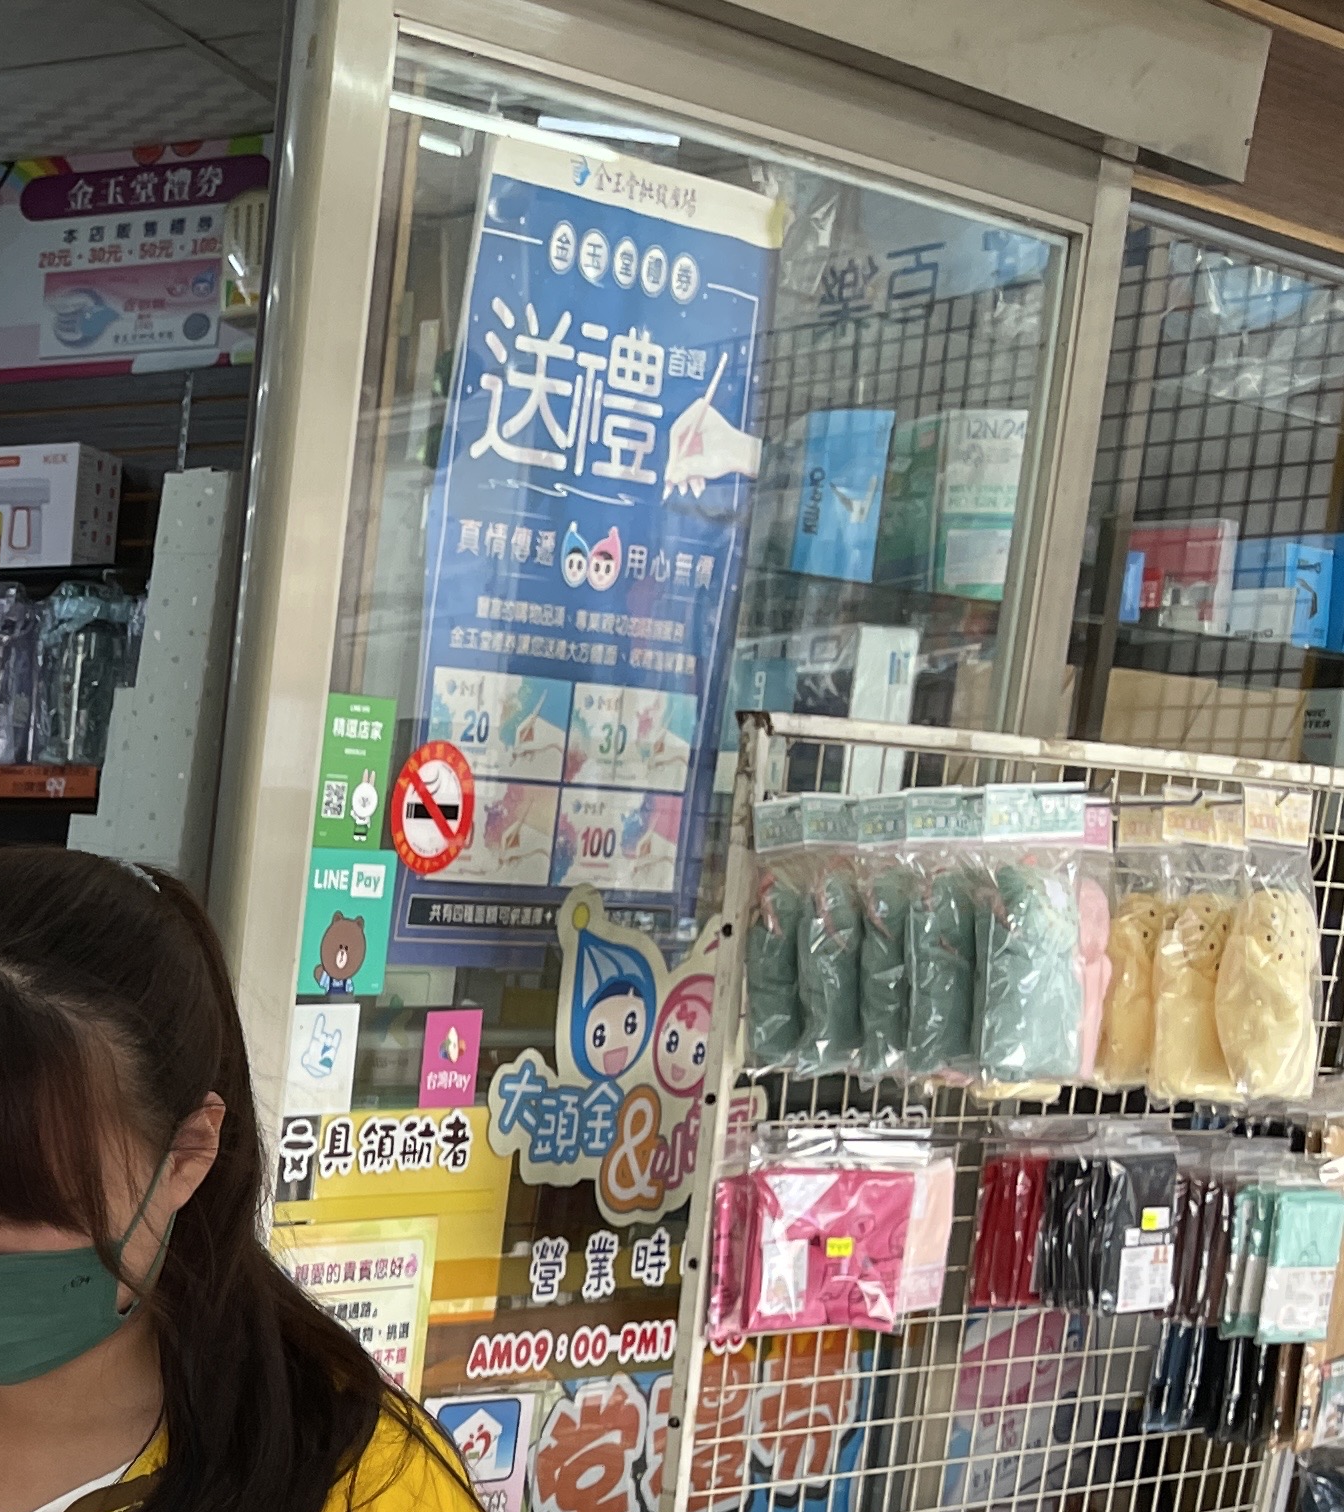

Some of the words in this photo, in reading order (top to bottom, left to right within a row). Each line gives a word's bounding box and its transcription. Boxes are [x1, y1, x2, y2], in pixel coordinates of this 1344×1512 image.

[469, 296, 665, 486] 送禮
[459, 710, 490, 744] 20
[580, 825, 616, 858] 100
[314, 869, 350, 891] LINE
[356, 871, 381, 893] Pay
[499, 1059, 624, 1167] 大頭金
